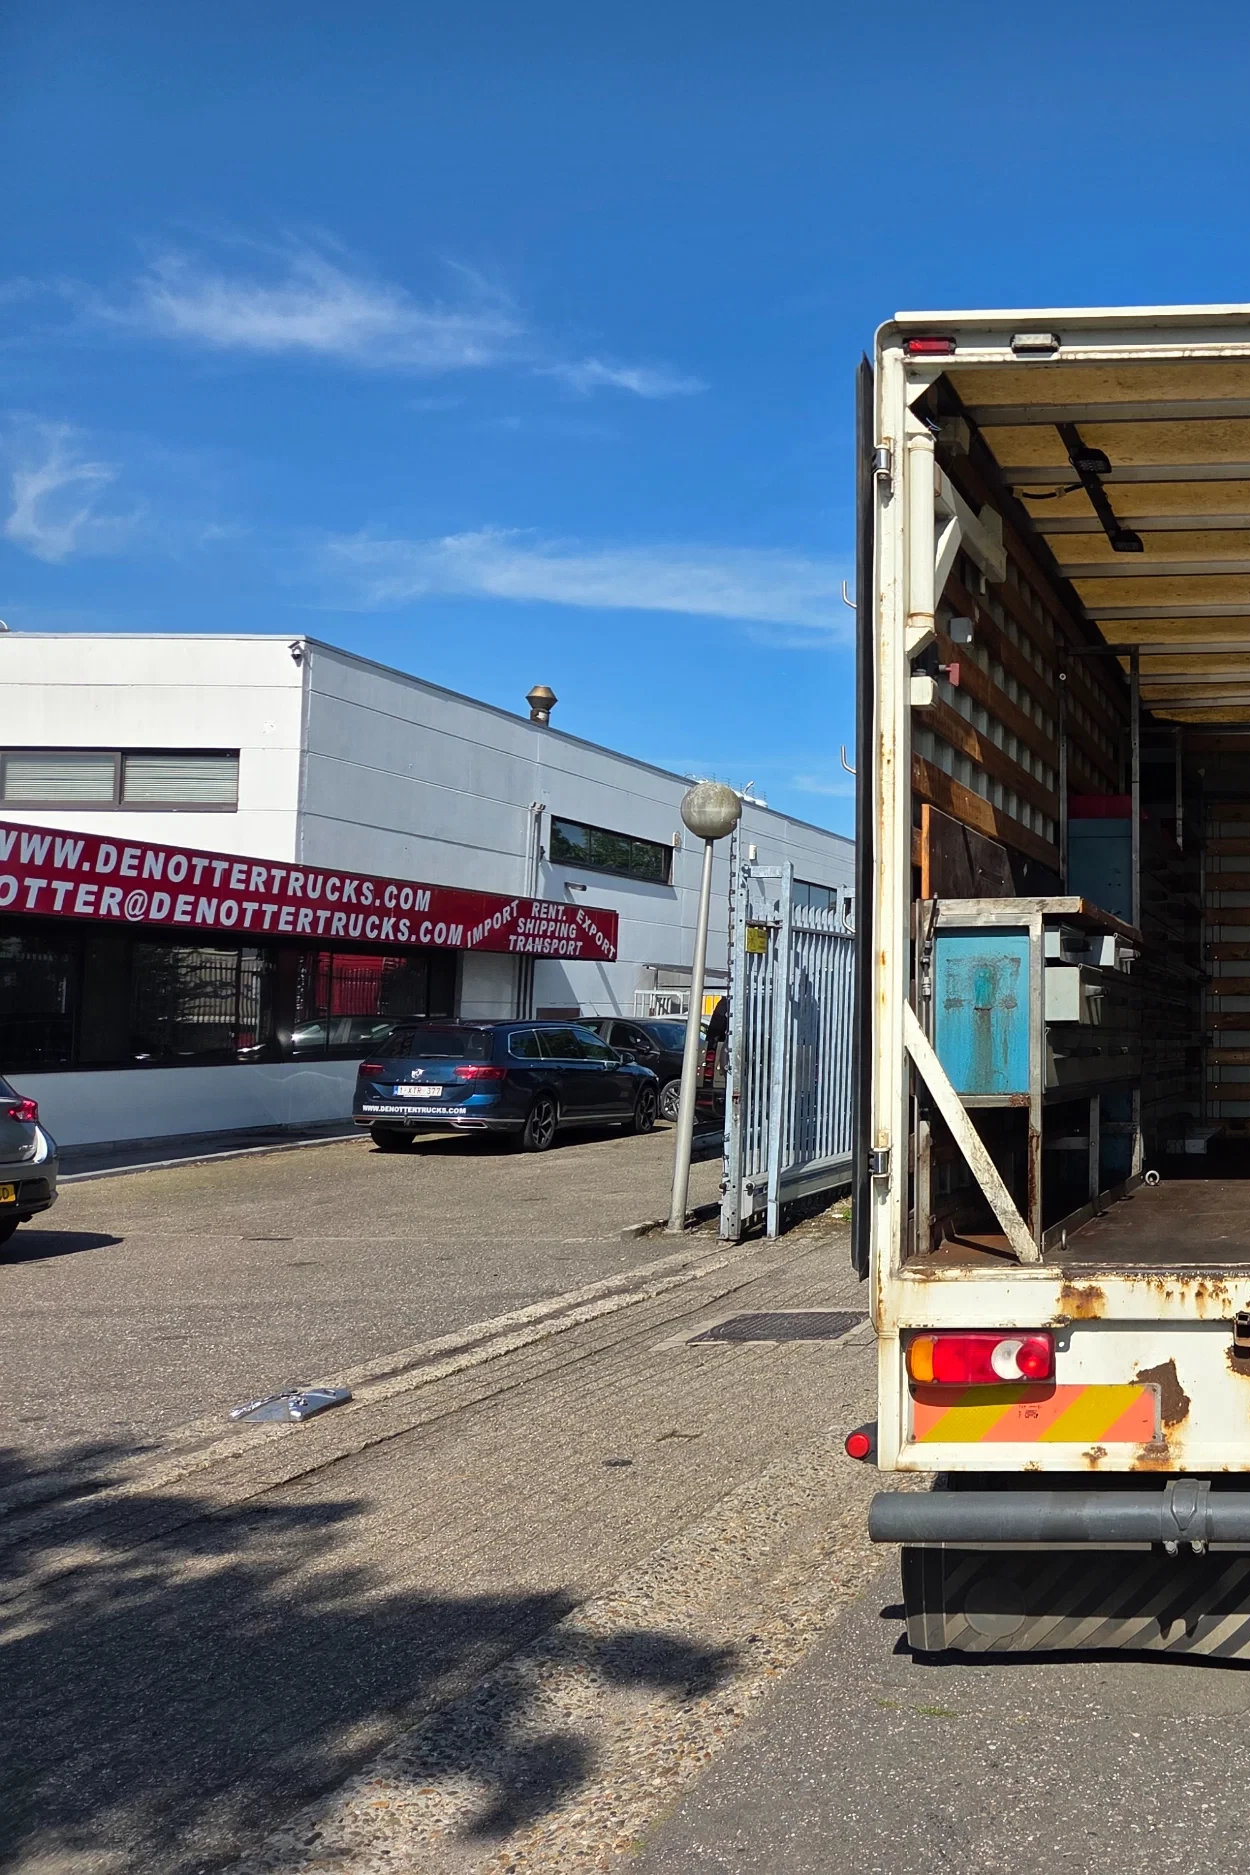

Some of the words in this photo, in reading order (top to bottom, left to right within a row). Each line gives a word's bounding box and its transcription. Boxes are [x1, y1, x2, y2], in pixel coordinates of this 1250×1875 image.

[531, 902, 567, 921] RENT.
[467, 900, 519, 948] IMPORT
[516, 917, 577, 938] SHIPPING
[576, 908, 616, 959] EXPORT
[508, 935, 583, 956] TRANSPORT
[362, 1104, 467, 1114] WWW.DENOTTERTRUCKS.COM
